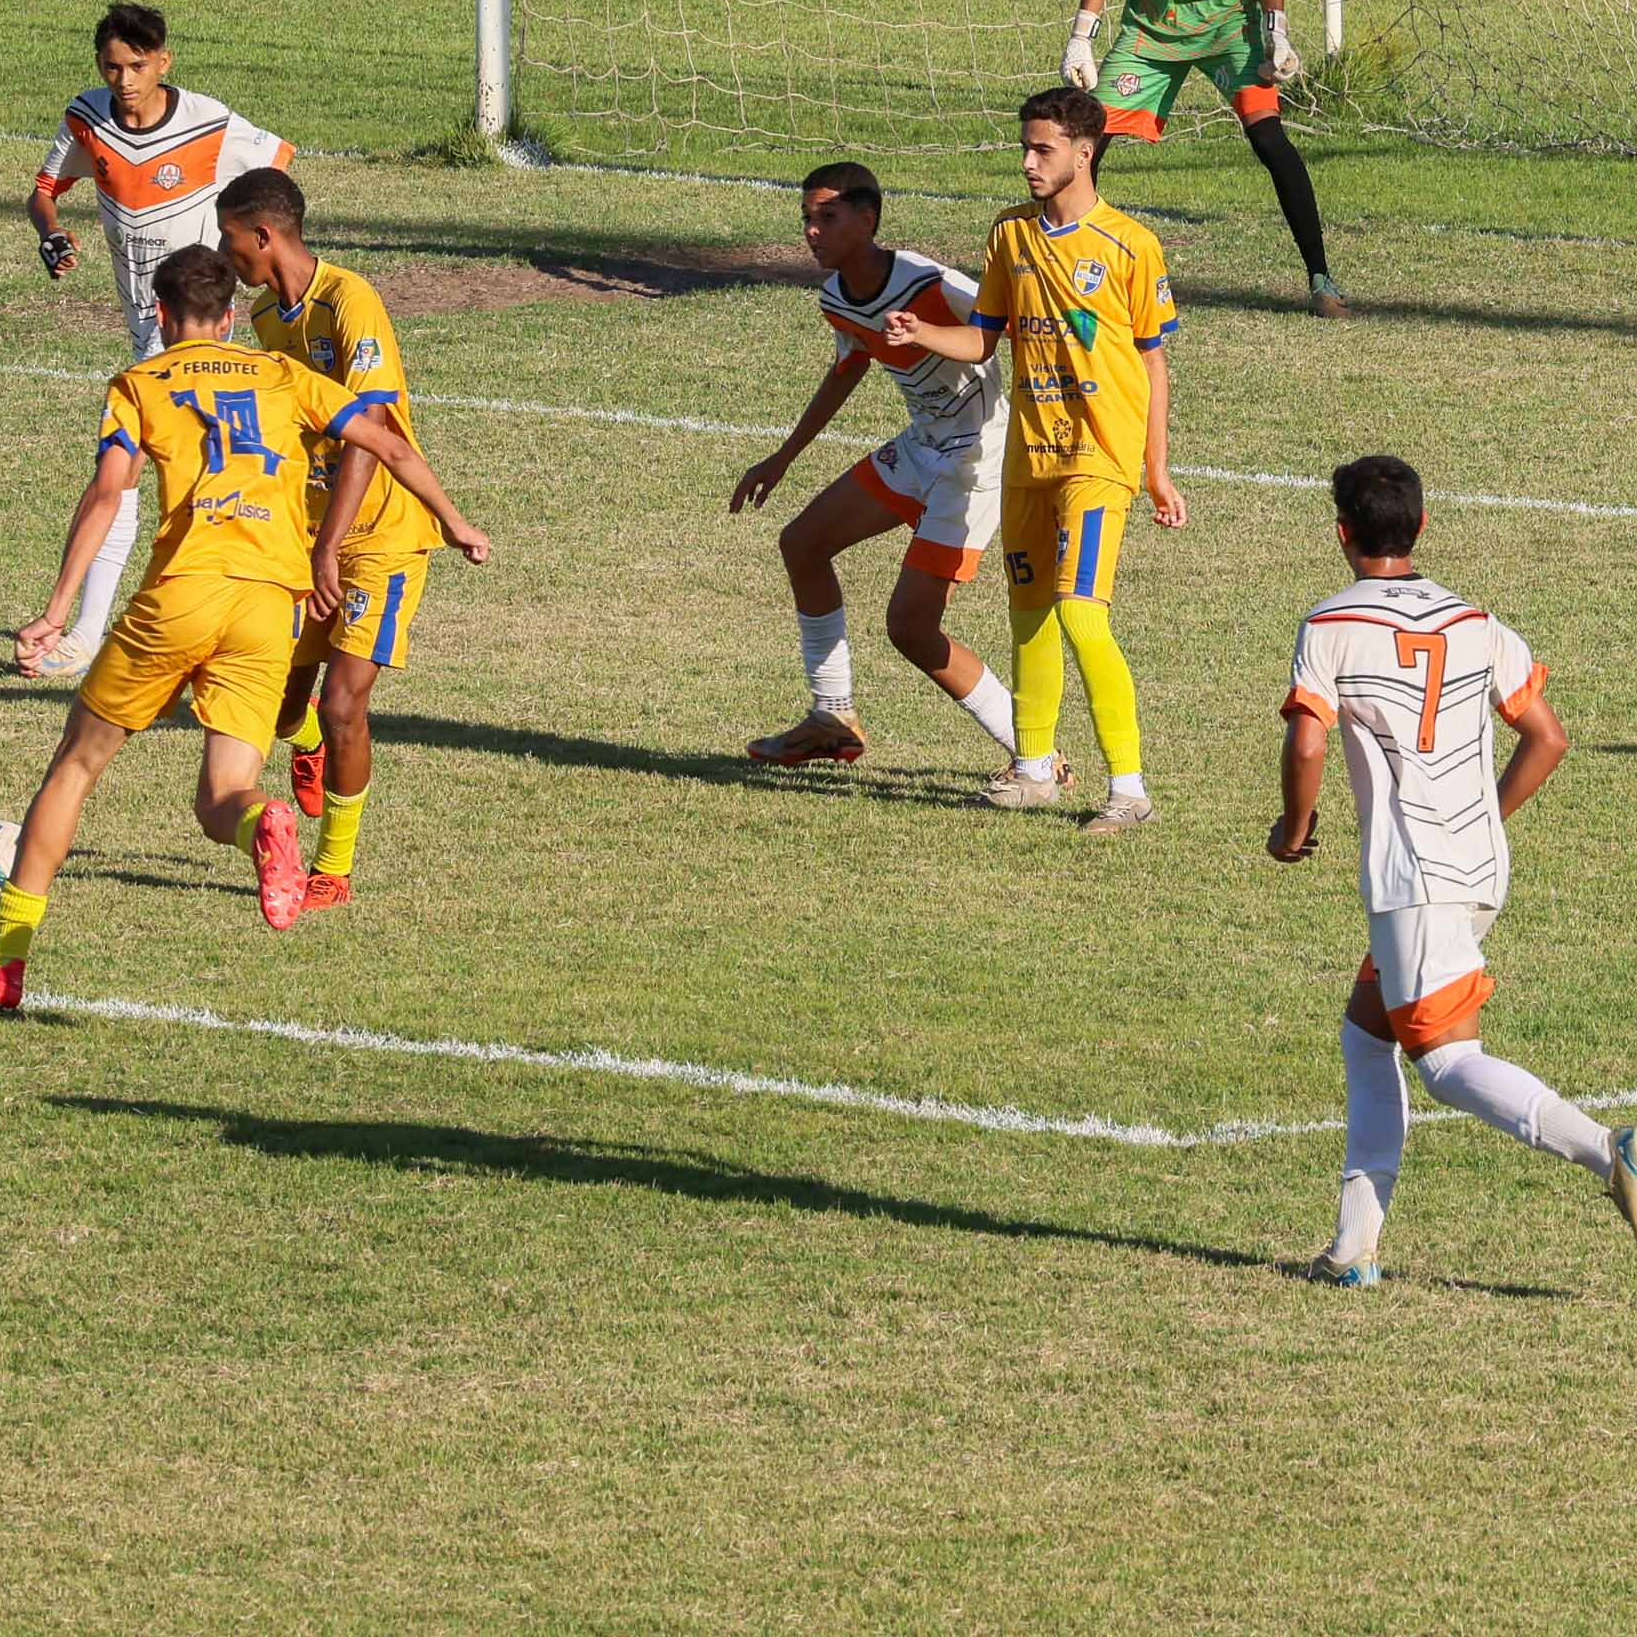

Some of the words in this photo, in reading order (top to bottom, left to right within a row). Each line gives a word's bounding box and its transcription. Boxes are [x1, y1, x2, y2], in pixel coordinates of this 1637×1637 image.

[125, 233, 167, 247] Semear
[169, 389, 287, 476] 14
[1006, 551, 1035, 586] 15
[1394, 631, 1448, 753] 7
